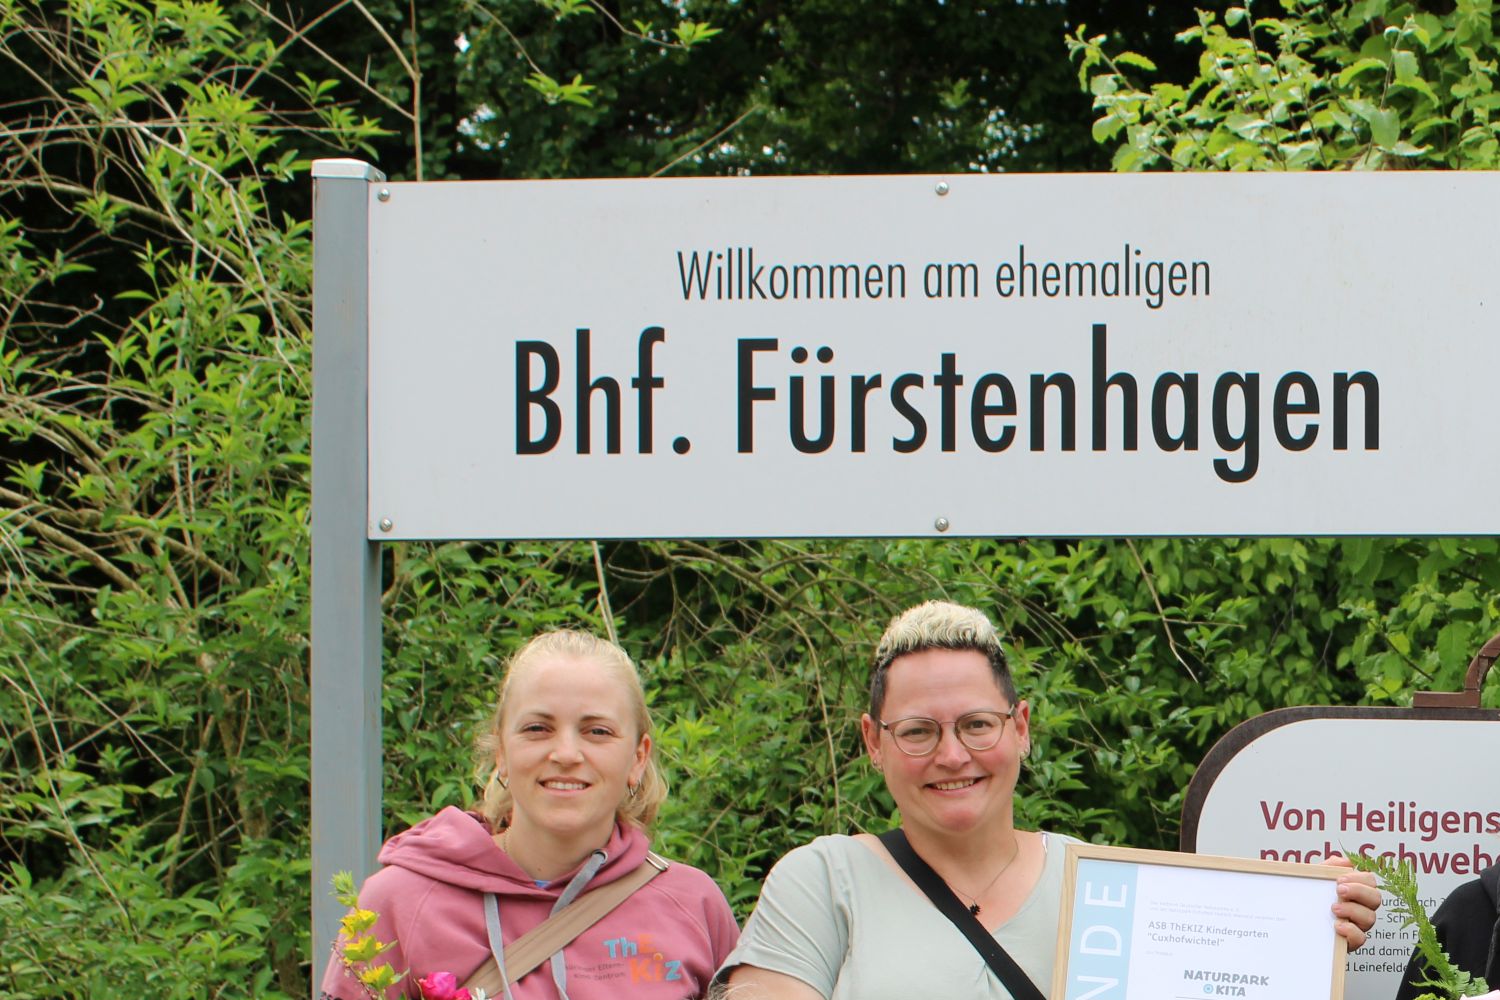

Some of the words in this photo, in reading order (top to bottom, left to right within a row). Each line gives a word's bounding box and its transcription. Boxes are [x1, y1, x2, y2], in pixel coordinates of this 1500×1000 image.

[677, 250, 906, 300] Willkommen
[924, 258, 979, 299] am
[996, 244, 1211, 309] ehemaligen
[515, 326, 692, 456] Bhf.
[736, 324, 1380, 483] Fürstenhagen
[1260, 801, 1325, 831] Von
[1149, 921, 1167, 930] ASB
[1206, 925, 1269, 938] Kindergarten
[1376, 930, 1395, 939] hier
[1400, 930, 1408, 939] in
[1379, 946, 1410, 956] damit
[1184, 970, 1269, 986] NATURPARK
[1216, 985, 1246, 996] KITA
